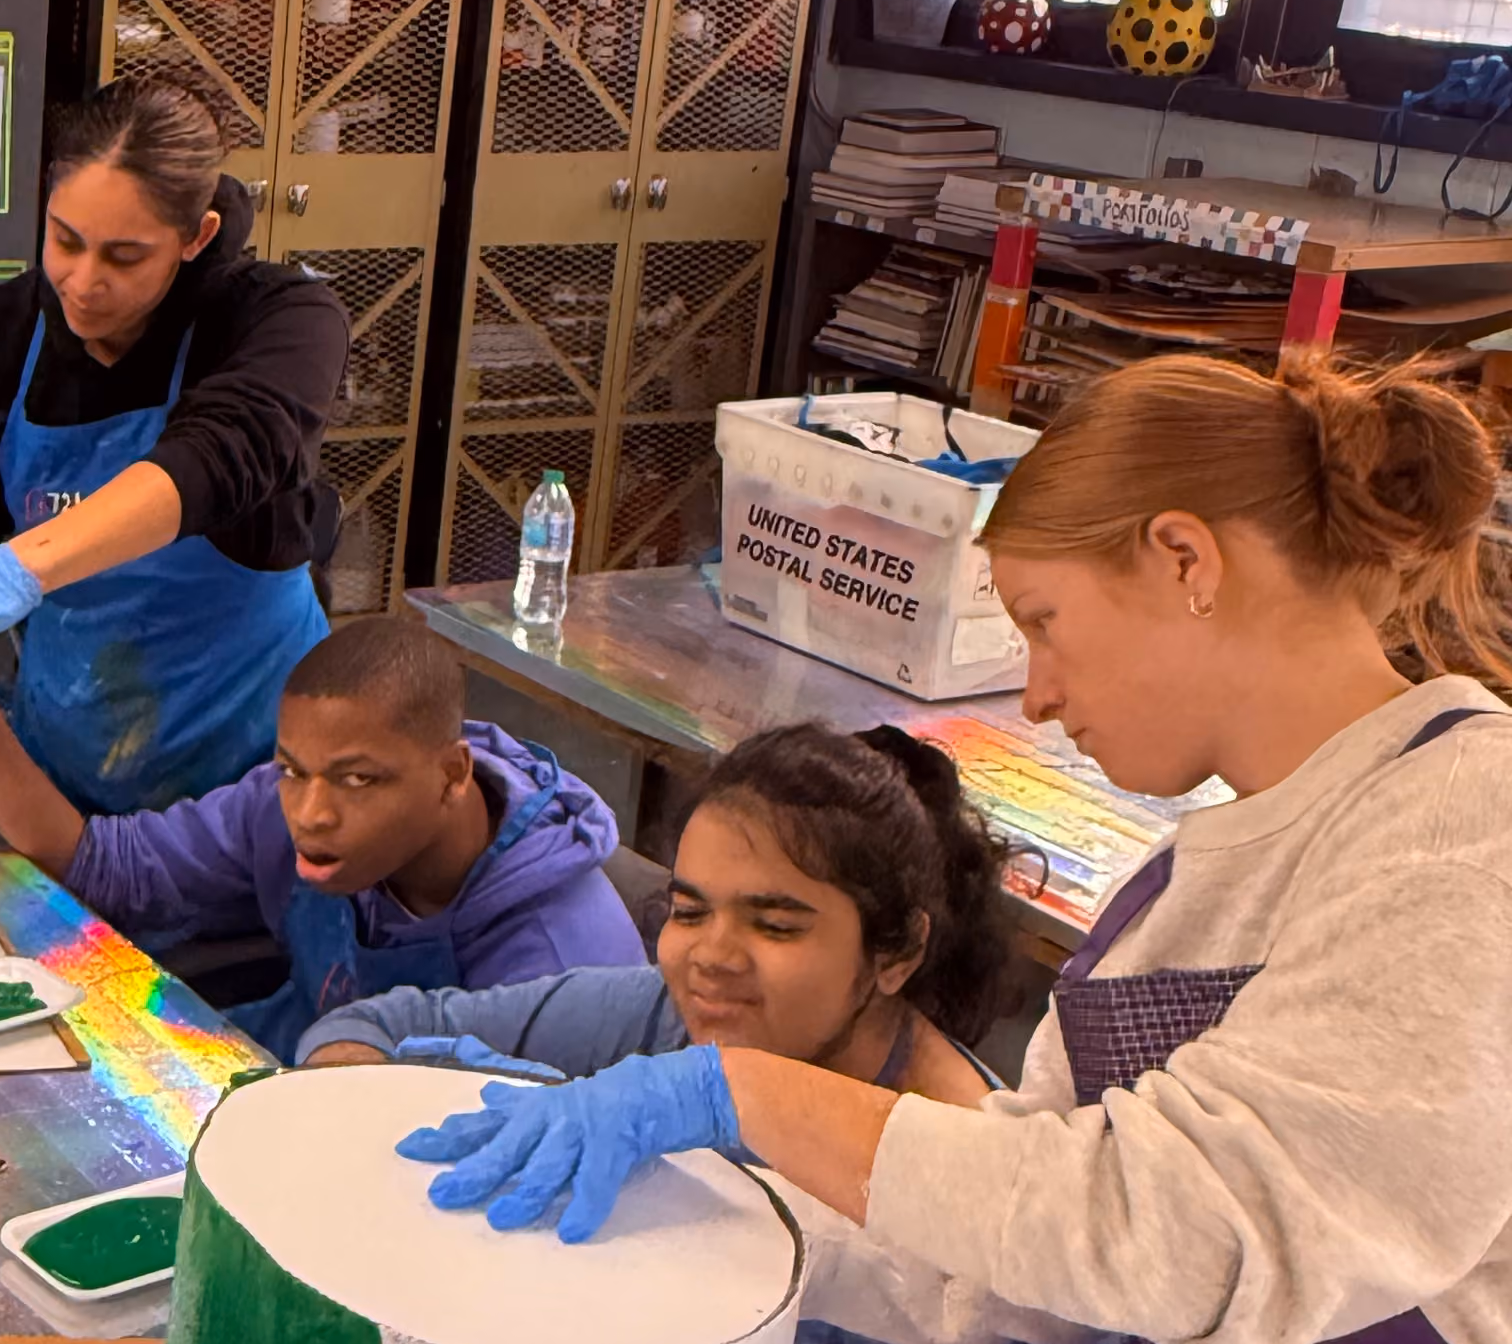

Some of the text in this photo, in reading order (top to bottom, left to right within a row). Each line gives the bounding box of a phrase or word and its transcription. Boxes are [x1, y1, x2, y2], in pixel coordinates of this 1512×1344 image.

[737, 533, 920, 622] POSTAL SERVICE
[747, 503, 915, 585] UNITED STATES
